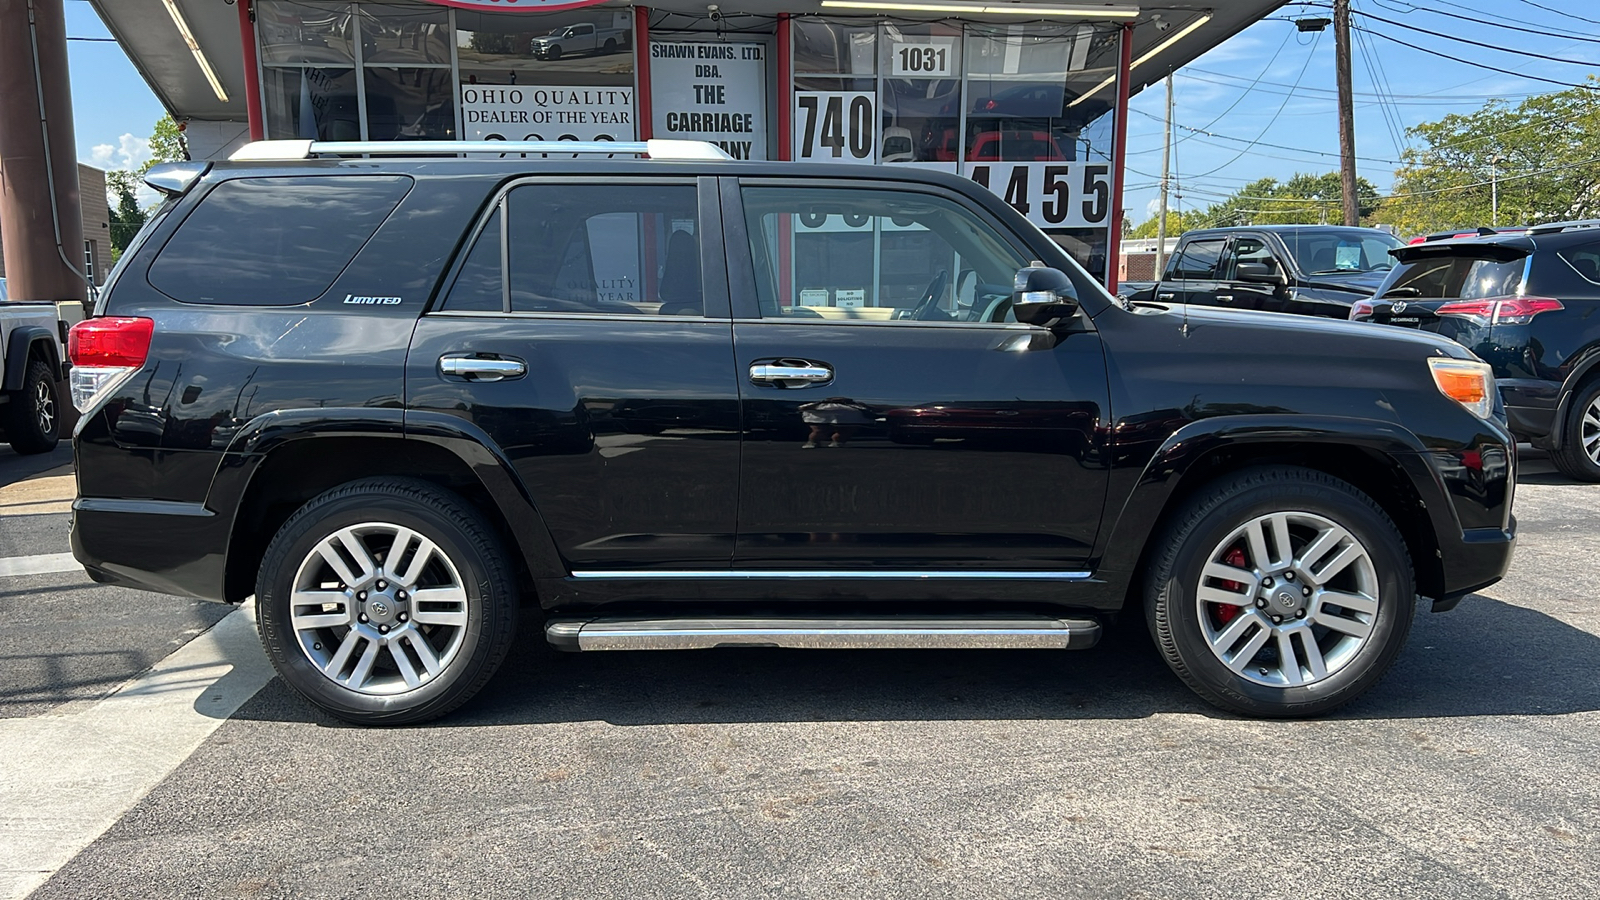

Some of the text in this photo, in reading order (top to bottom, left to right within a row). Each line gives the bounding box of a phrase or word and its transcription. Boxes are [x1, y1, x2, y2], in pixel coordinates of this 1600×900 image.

[652, 45, 763, 60] SHAWN EVANS. LTD.
[899, 47, 946, 71] 1031
[695, 65, 721, 78] DBA.
[465, 90, 631, 107] OHIO QUALITY
[693, 85, 725, 104] THE
[468, 111, 629, 123] DEALER OF THE YEAR
[667, 112, 752, 133] CARRIAGE
[799, 96, 872, 159] 740
[599, 292, 634, 300] YEAR
